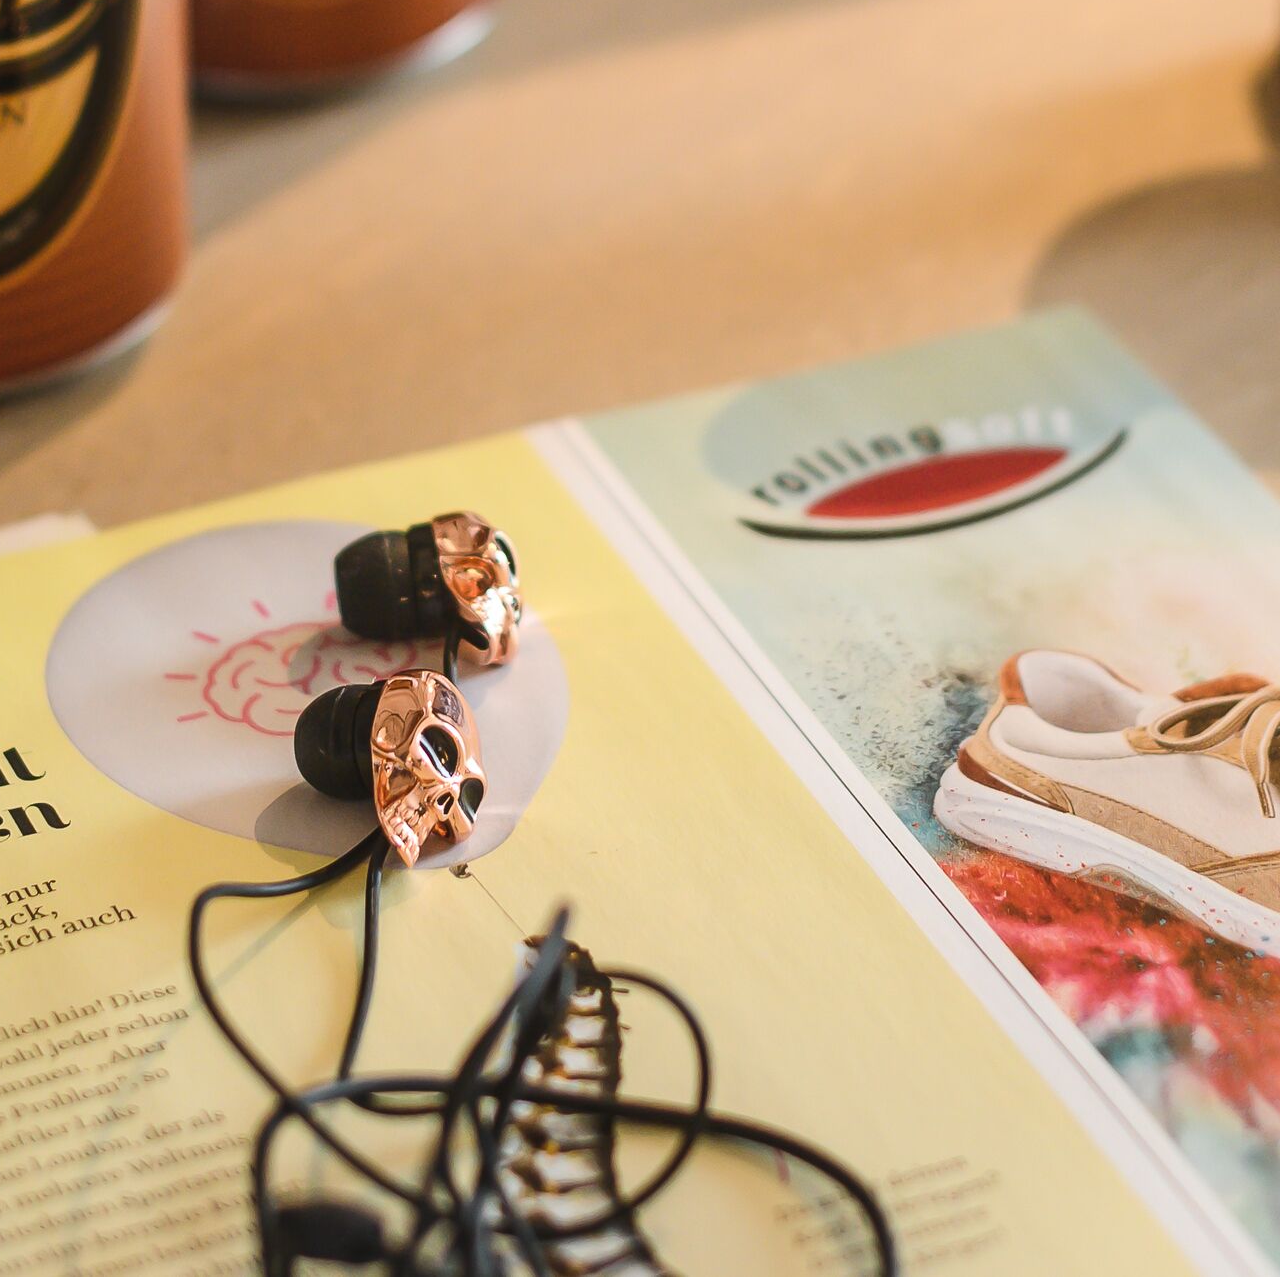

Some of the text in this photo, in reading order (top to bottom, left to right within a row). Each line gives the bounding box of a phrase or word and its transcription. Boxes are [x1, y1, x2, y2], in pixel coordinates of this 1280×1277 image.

[1, 878, 58, 905] nur
[61, 904, 138, 936] auch
[51, 999, 105, 1027] hin!
[108, 982, 178, 1011] Diese
[48, 1025, 111, 1060] jeder
[117, 1004, 190, 1036] schon
